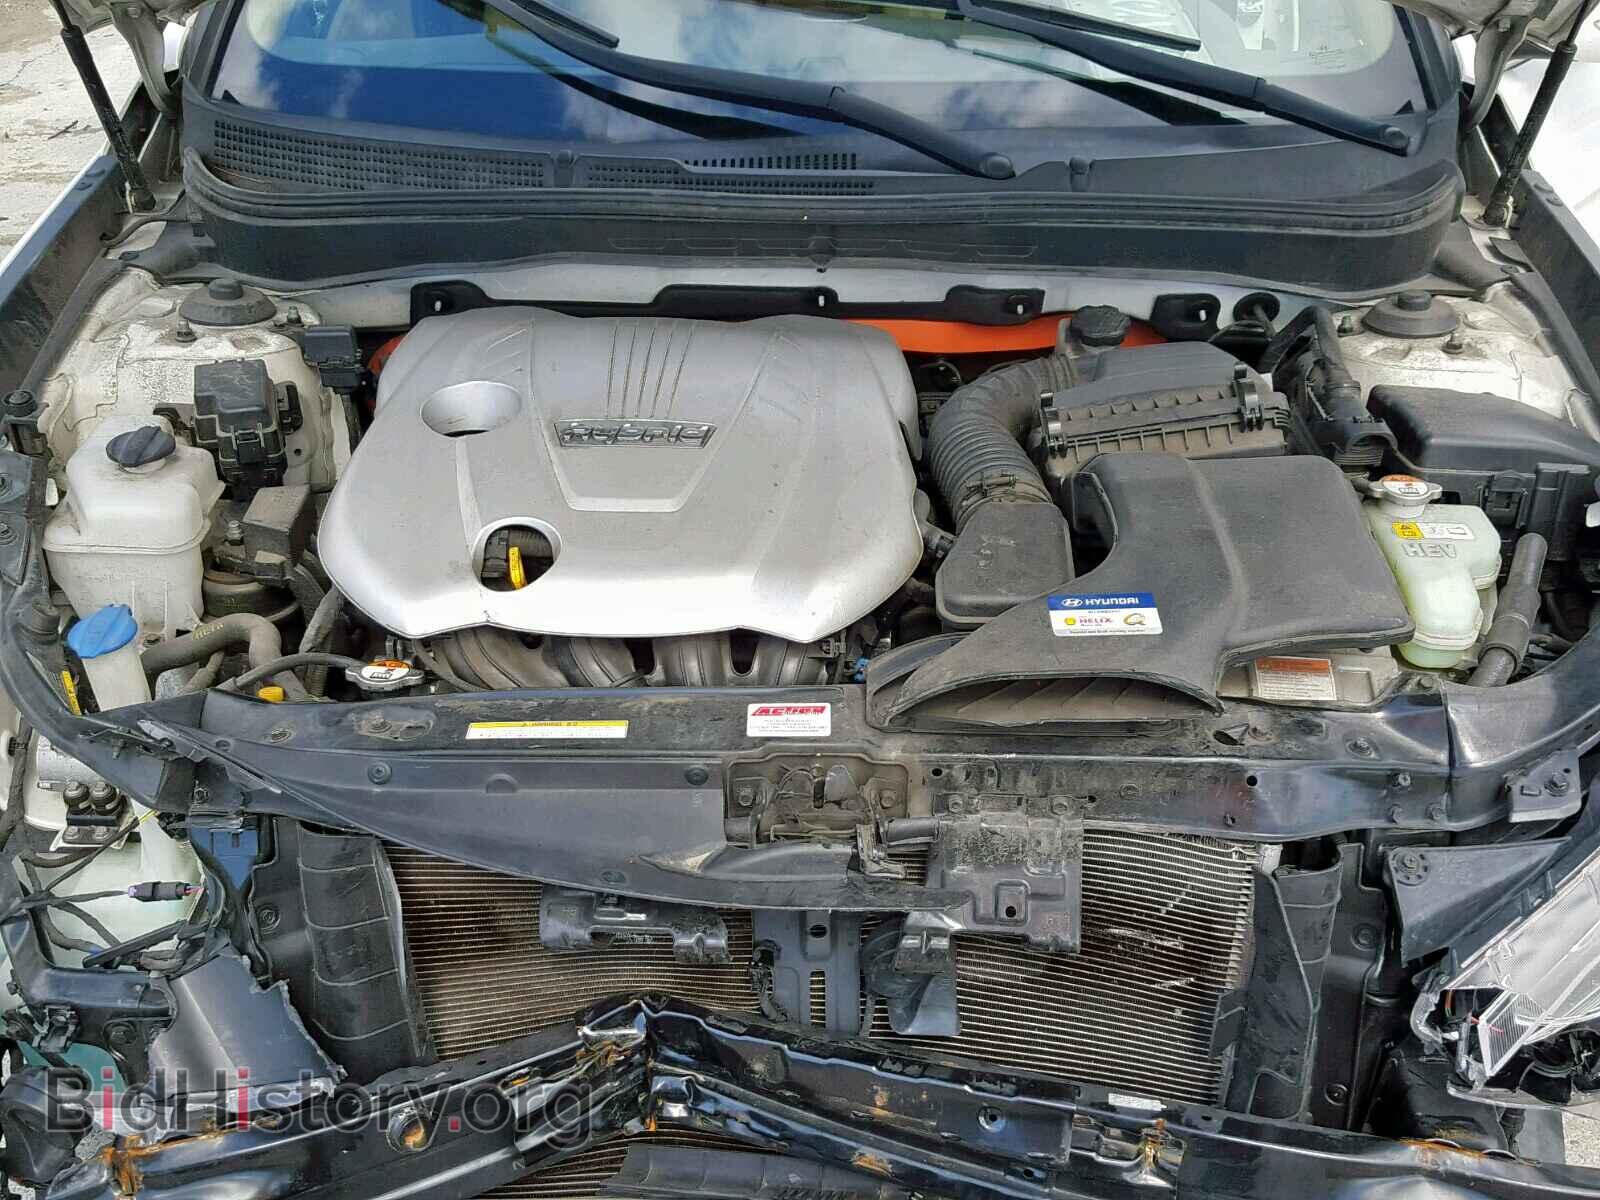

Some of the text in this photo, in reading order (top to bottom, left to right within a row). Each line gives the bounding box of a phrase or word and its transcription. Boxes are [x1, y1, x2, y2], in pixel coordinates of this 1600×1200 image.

[1402, 543, 1457, 558] HEV
[1084, 596, 1140, 606] HYUNDAI
[1079, 616, 1113, 625] HELIX
